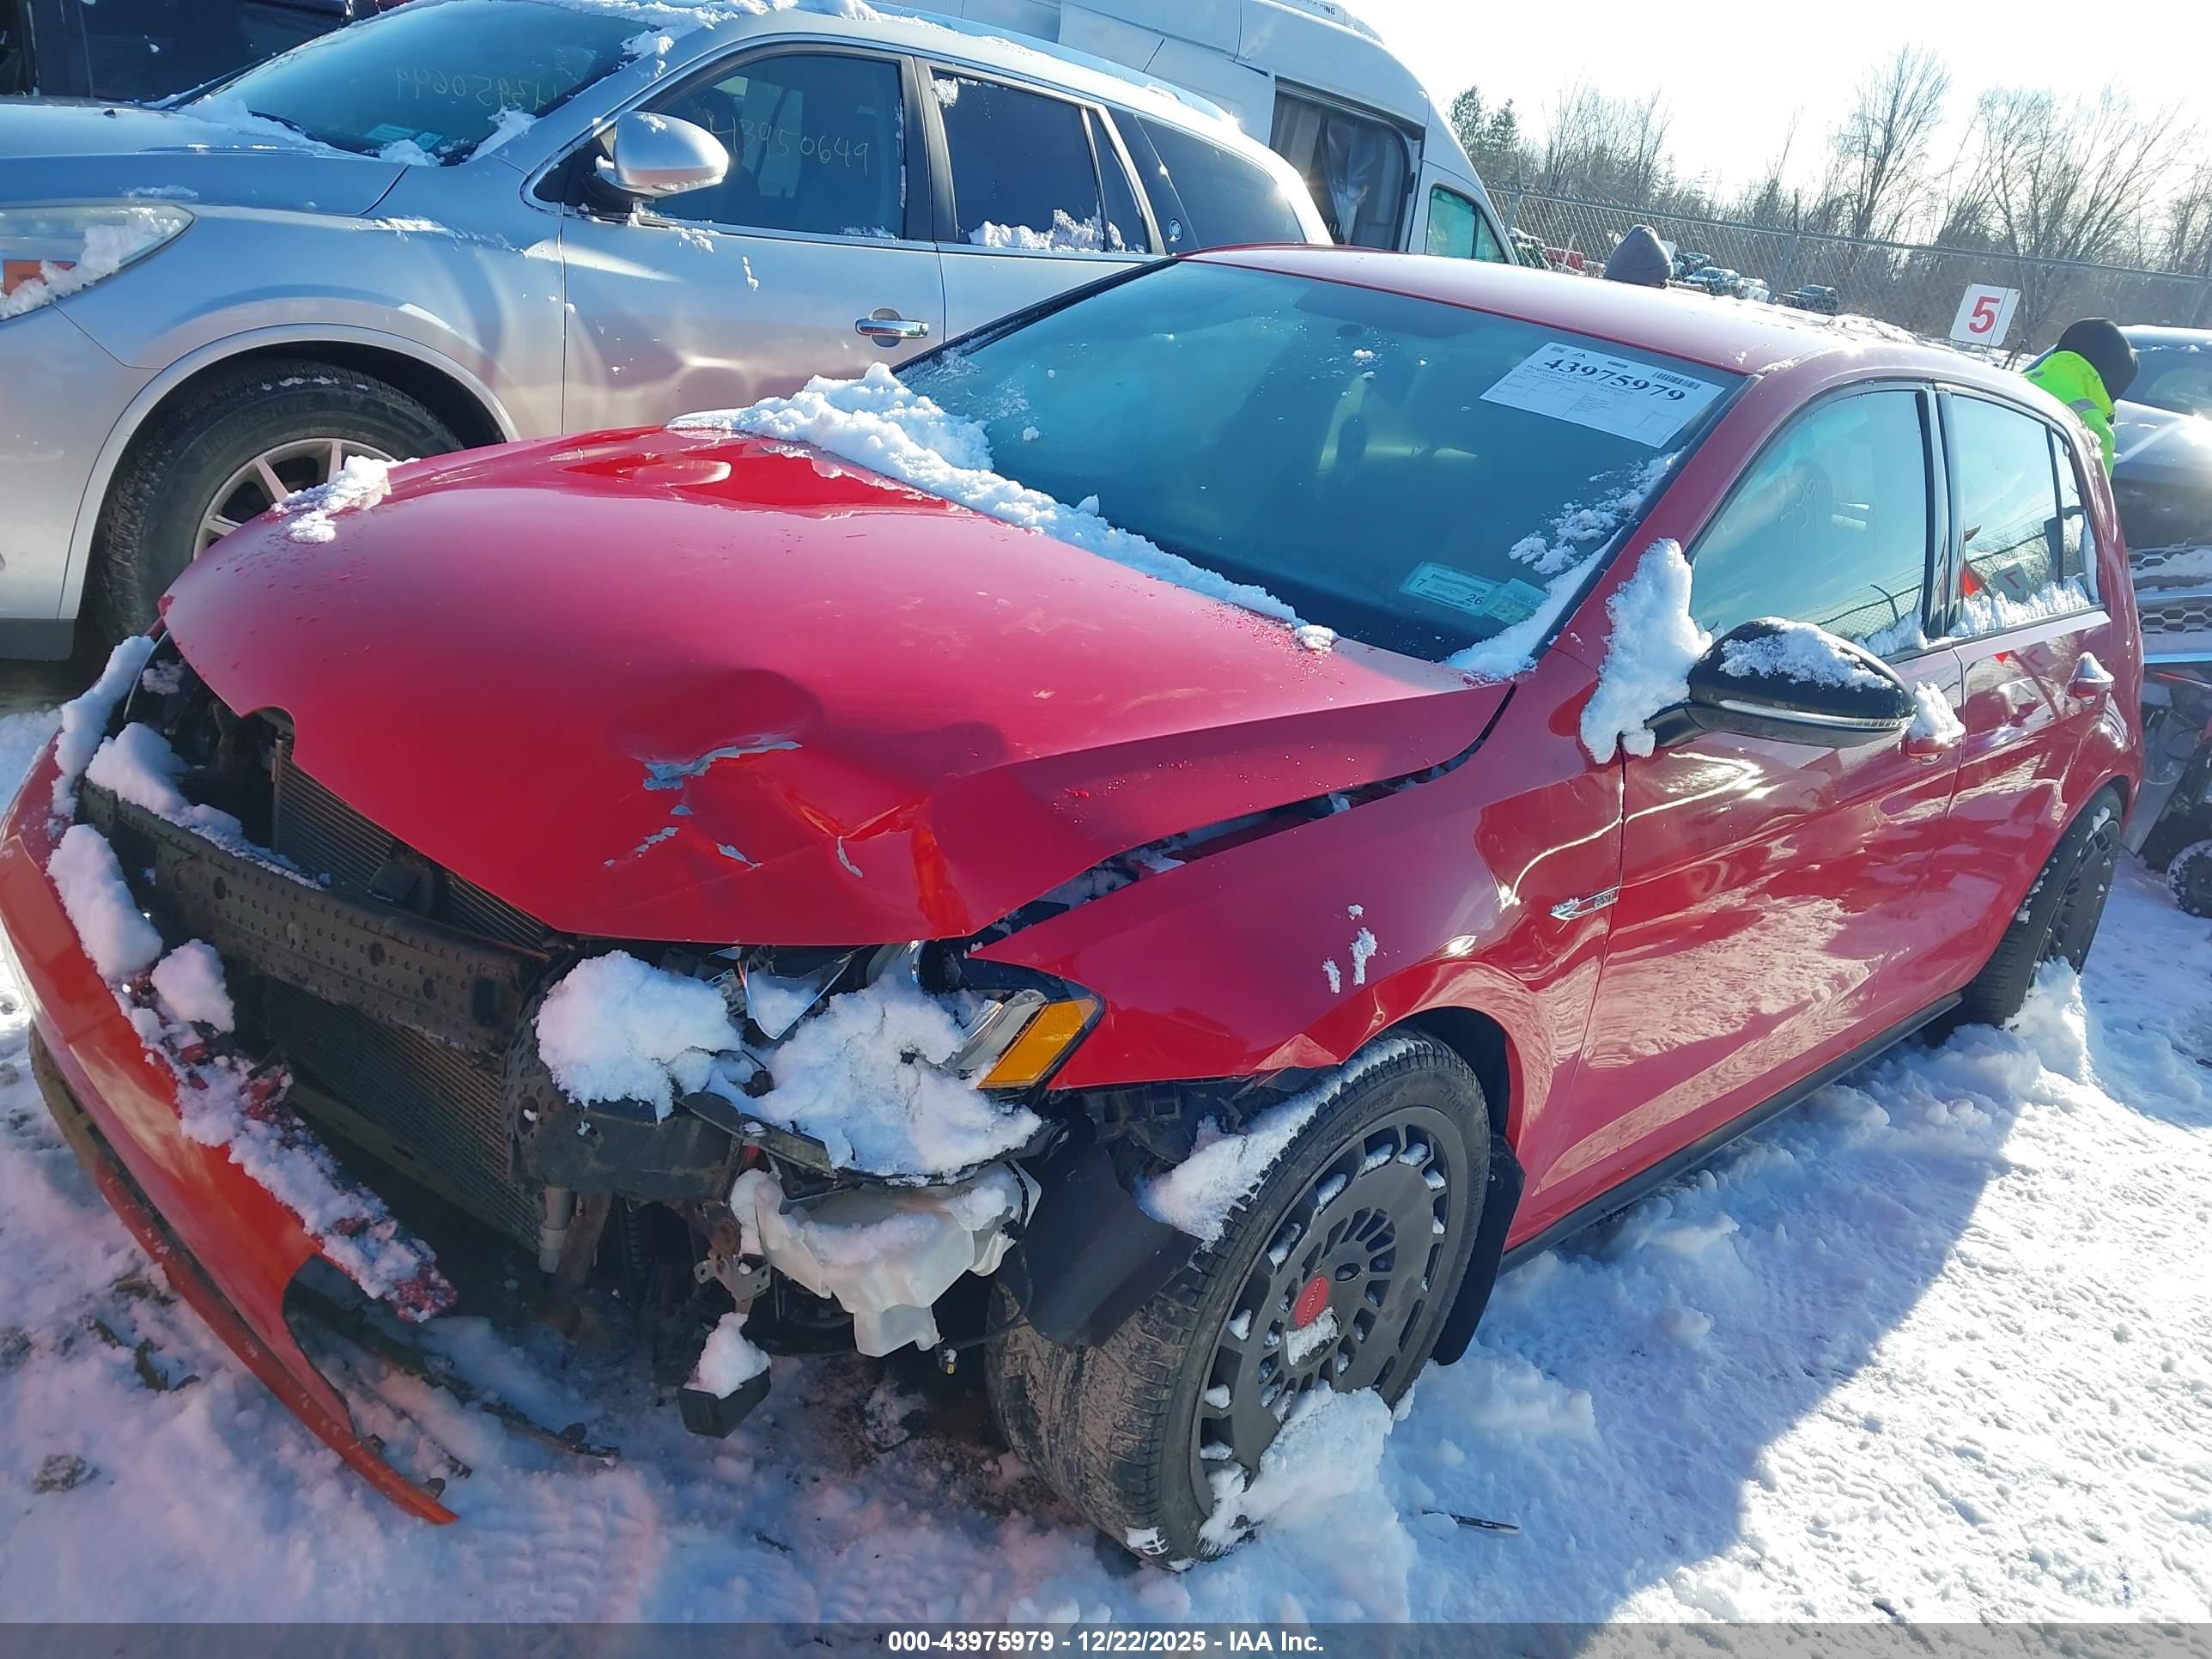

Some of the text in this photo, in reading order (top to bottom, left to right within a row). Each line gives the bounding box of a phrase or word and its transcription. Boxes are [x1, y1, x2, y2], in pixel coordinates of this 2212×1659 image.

[708, 113, 868, 175] 43950649
[1968, 295, 2002, 334] 5
[1543, 358, 1686, 401] 43975979
[1415, 578, 1428, 588] 7
[1465, 592, 1486, 605] 26
